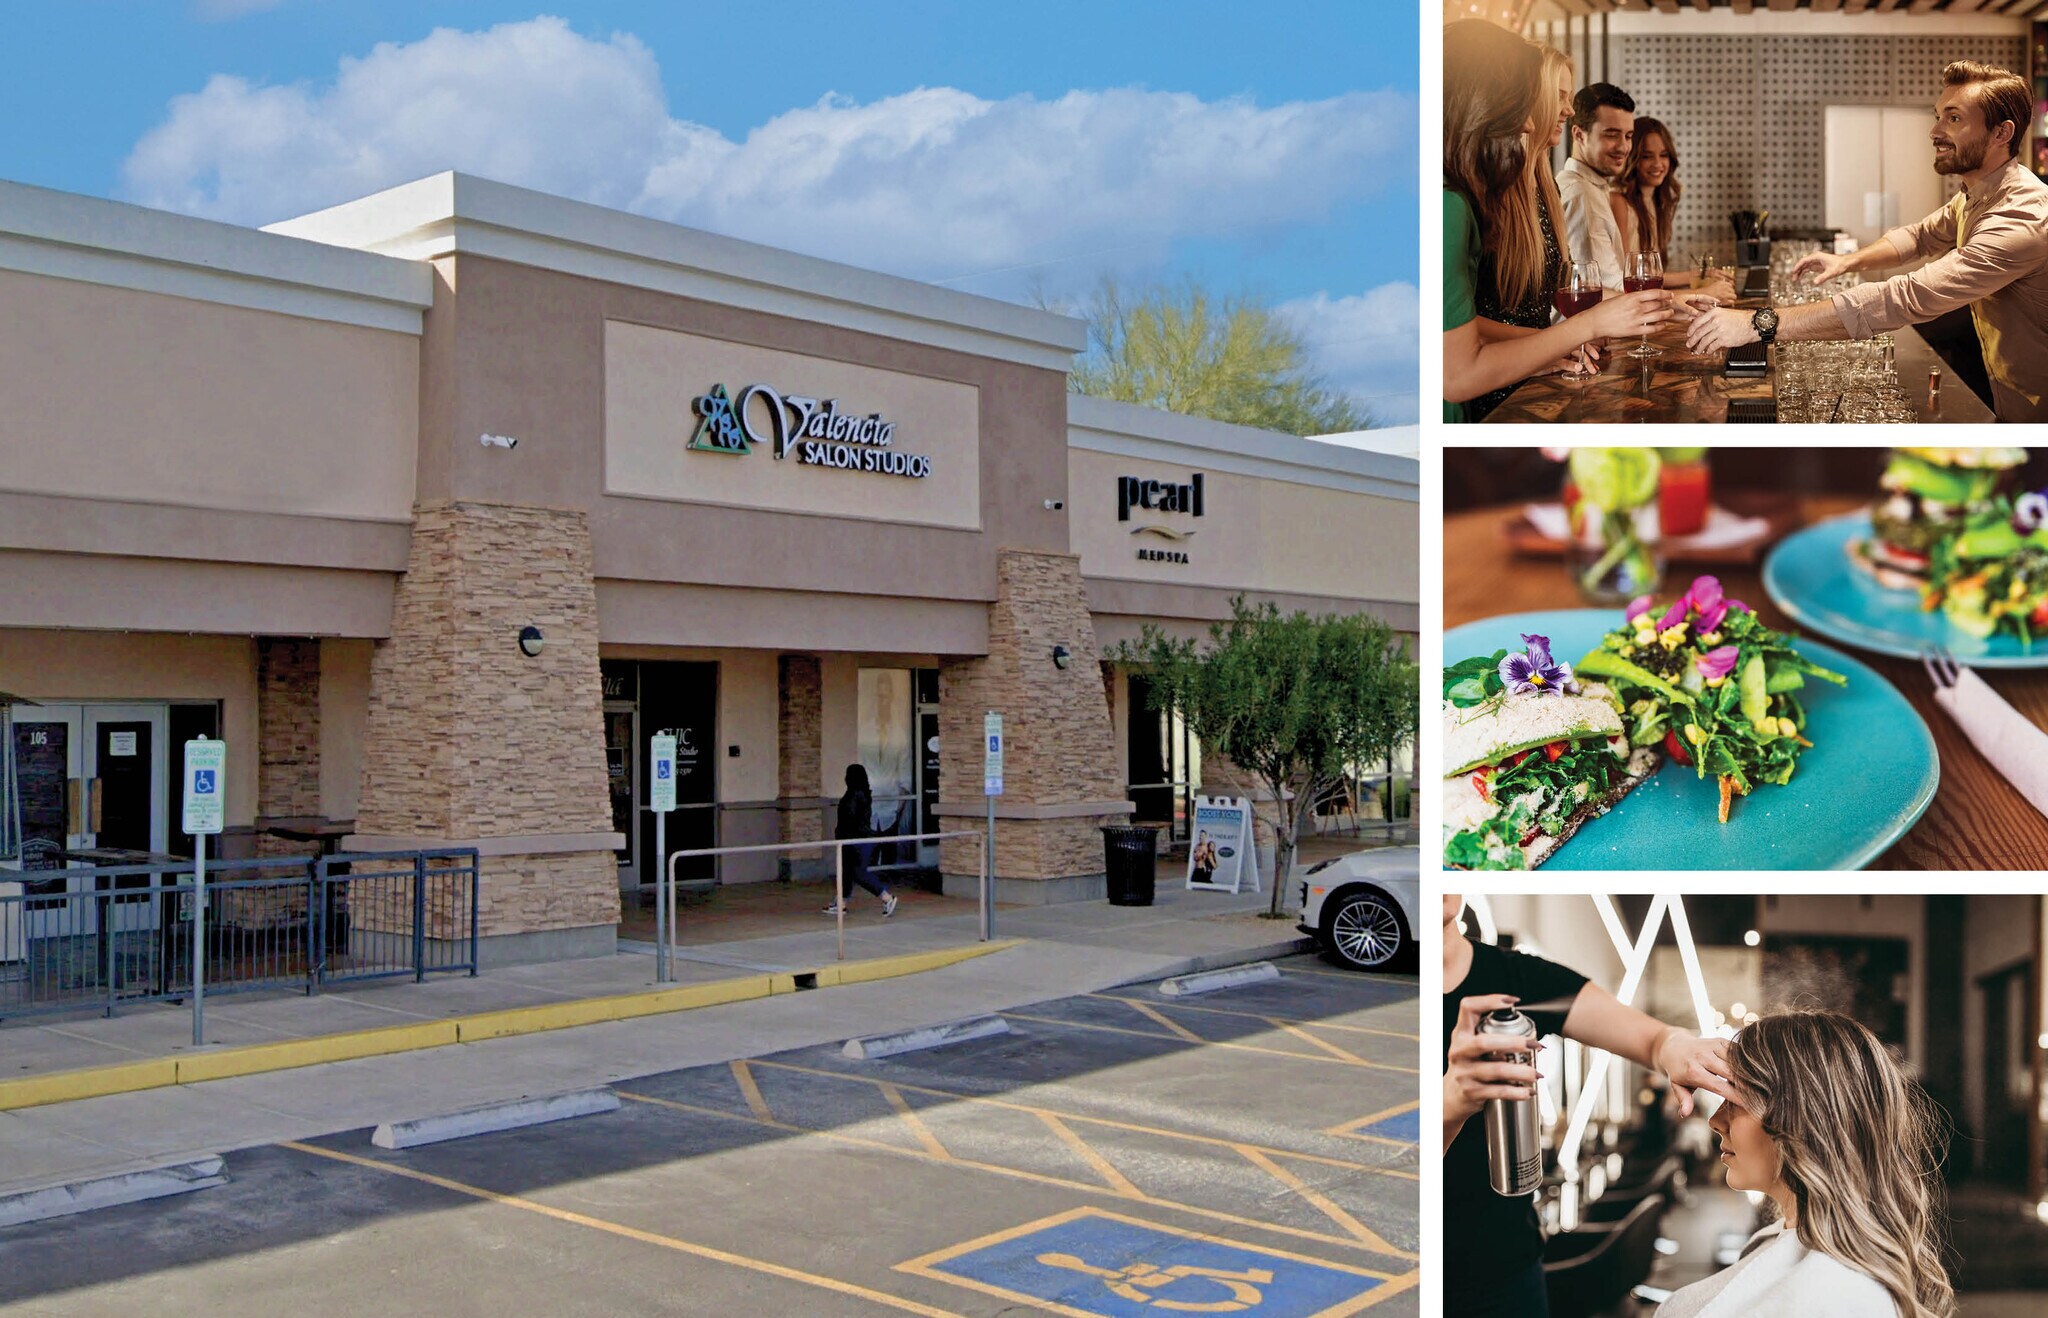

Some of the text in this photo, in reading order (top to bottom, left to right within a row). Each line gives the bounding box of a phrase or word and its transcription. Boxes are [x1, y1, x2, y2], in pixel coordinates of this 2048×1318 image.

[737, 383, 896, 459] Valencia
[802, 441, 932, 478] SALON STUDIOS
[1118, 473, 1204, 521] pearl
[1137, 549, 1189, 564] MEDSPA
[30, 731, 48, 745] 105
